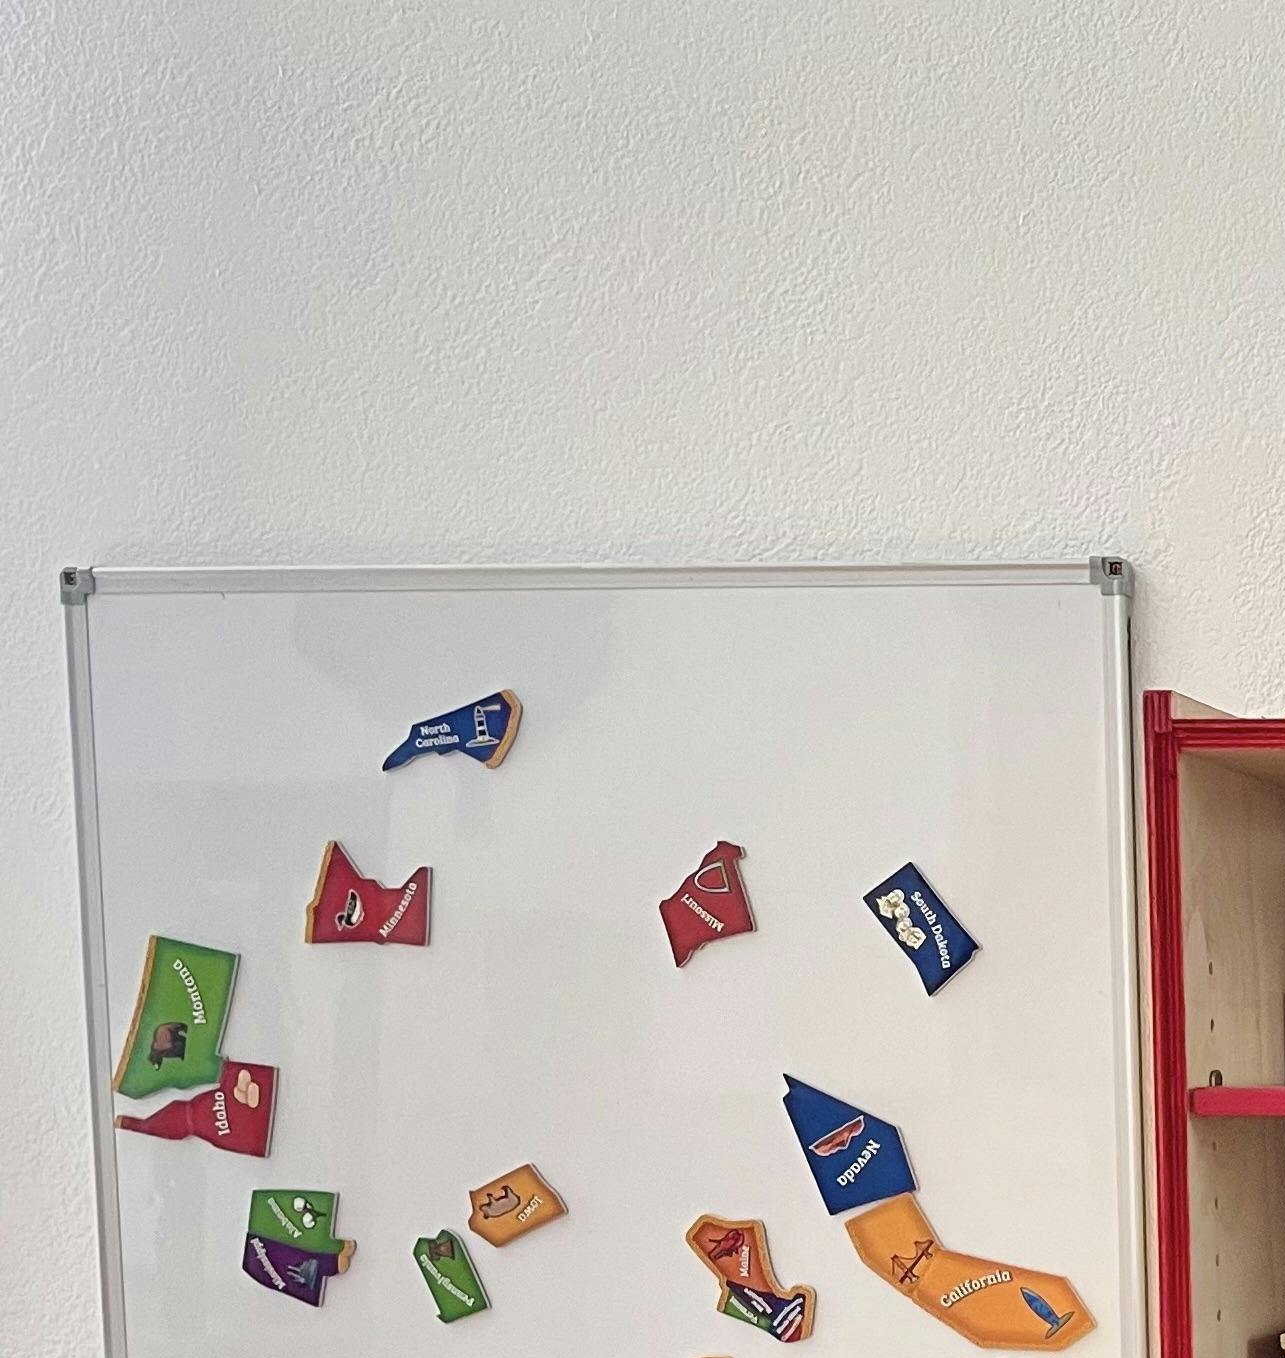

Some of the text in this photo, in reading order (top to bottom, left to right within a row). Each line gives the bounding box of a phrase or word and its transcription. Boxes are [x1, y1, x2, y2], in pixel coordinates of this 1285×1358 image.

[416, 735, 460, 748] Carolina
[420, 722, 451, 736] North
[379, 881, 416, 938] Minnesota
[681, 893, 724, 932] Missouri
[911, 892, 951, 969] South Dakota
[173, 960, 207, 1024] Montana
[212, 1091, 230, 1136] Idaho
[837, 1139, 881, 1187] Nevada
[518, 1195, 543, 1223] Iowa
[739, 1244, 750, 1277] Maine
[940, 1269, 1013, 1308] California
